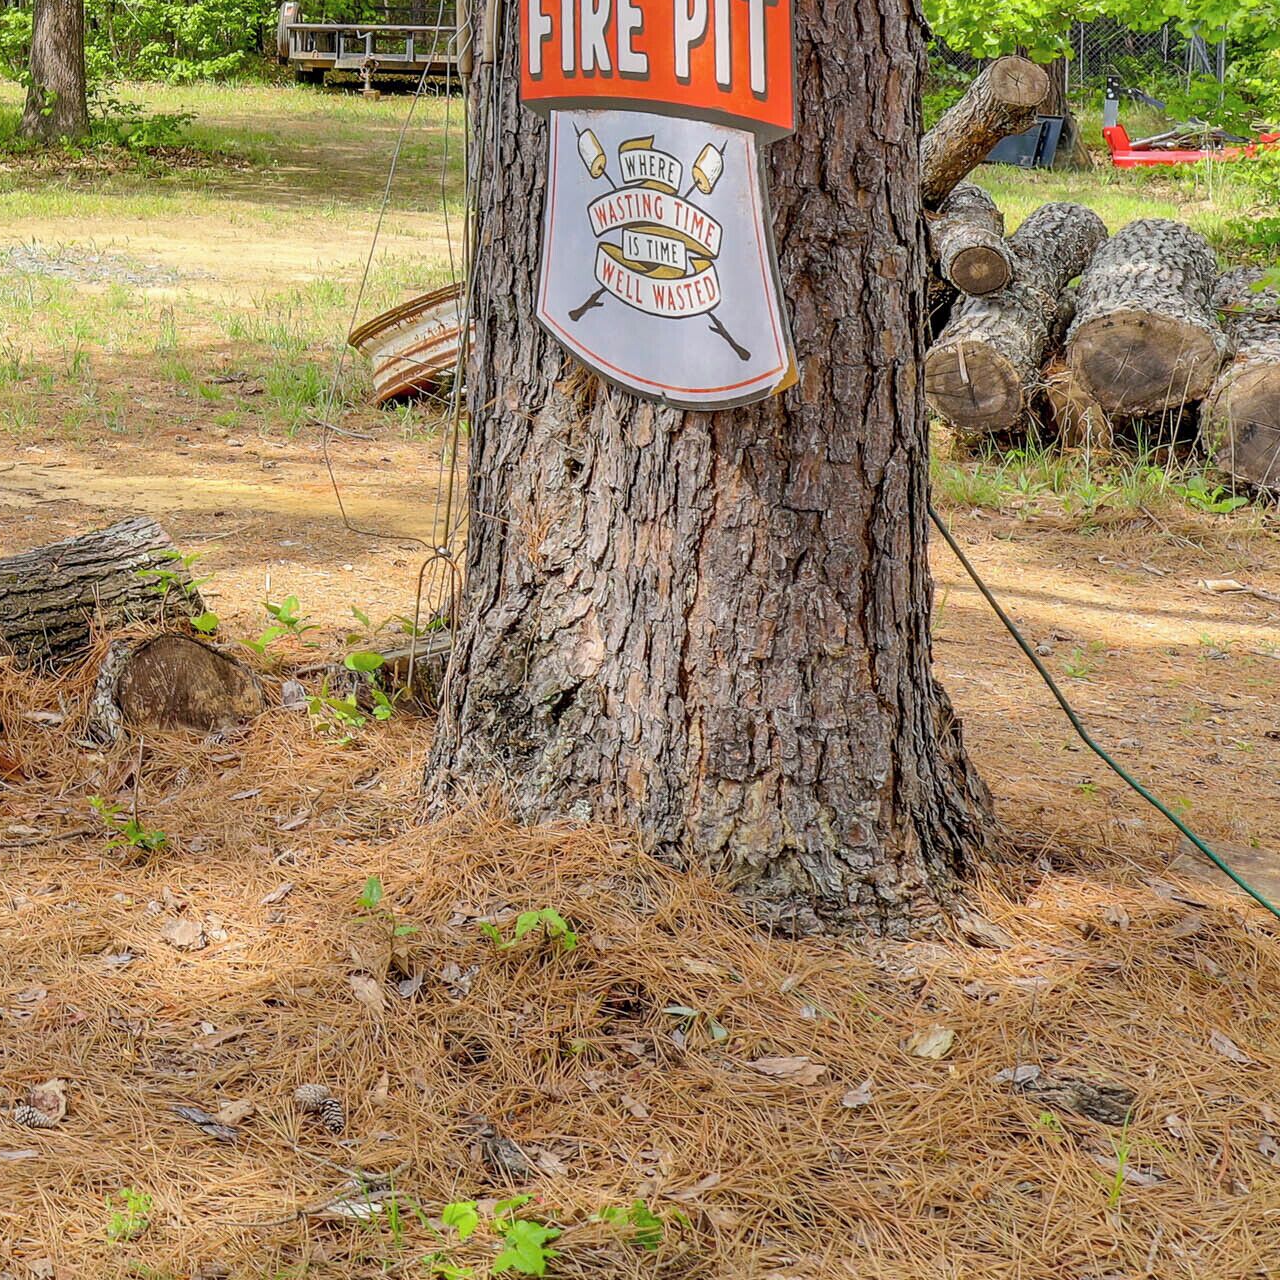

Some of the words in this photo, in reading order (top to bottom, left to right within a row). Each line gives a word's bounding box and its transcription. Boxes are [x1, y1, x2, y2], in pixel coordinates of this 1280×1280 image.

[624, 156, 674, 184] WHERE
[594, 194, 663, 228] WASTING
[674, 199, 716, 248] TIME
[628, 235, 639, 256] IS
[646, 239, 678, 264] TIME
[601, 260, 642, 304] WELL
[652, 275, 716, 312] WASTED
